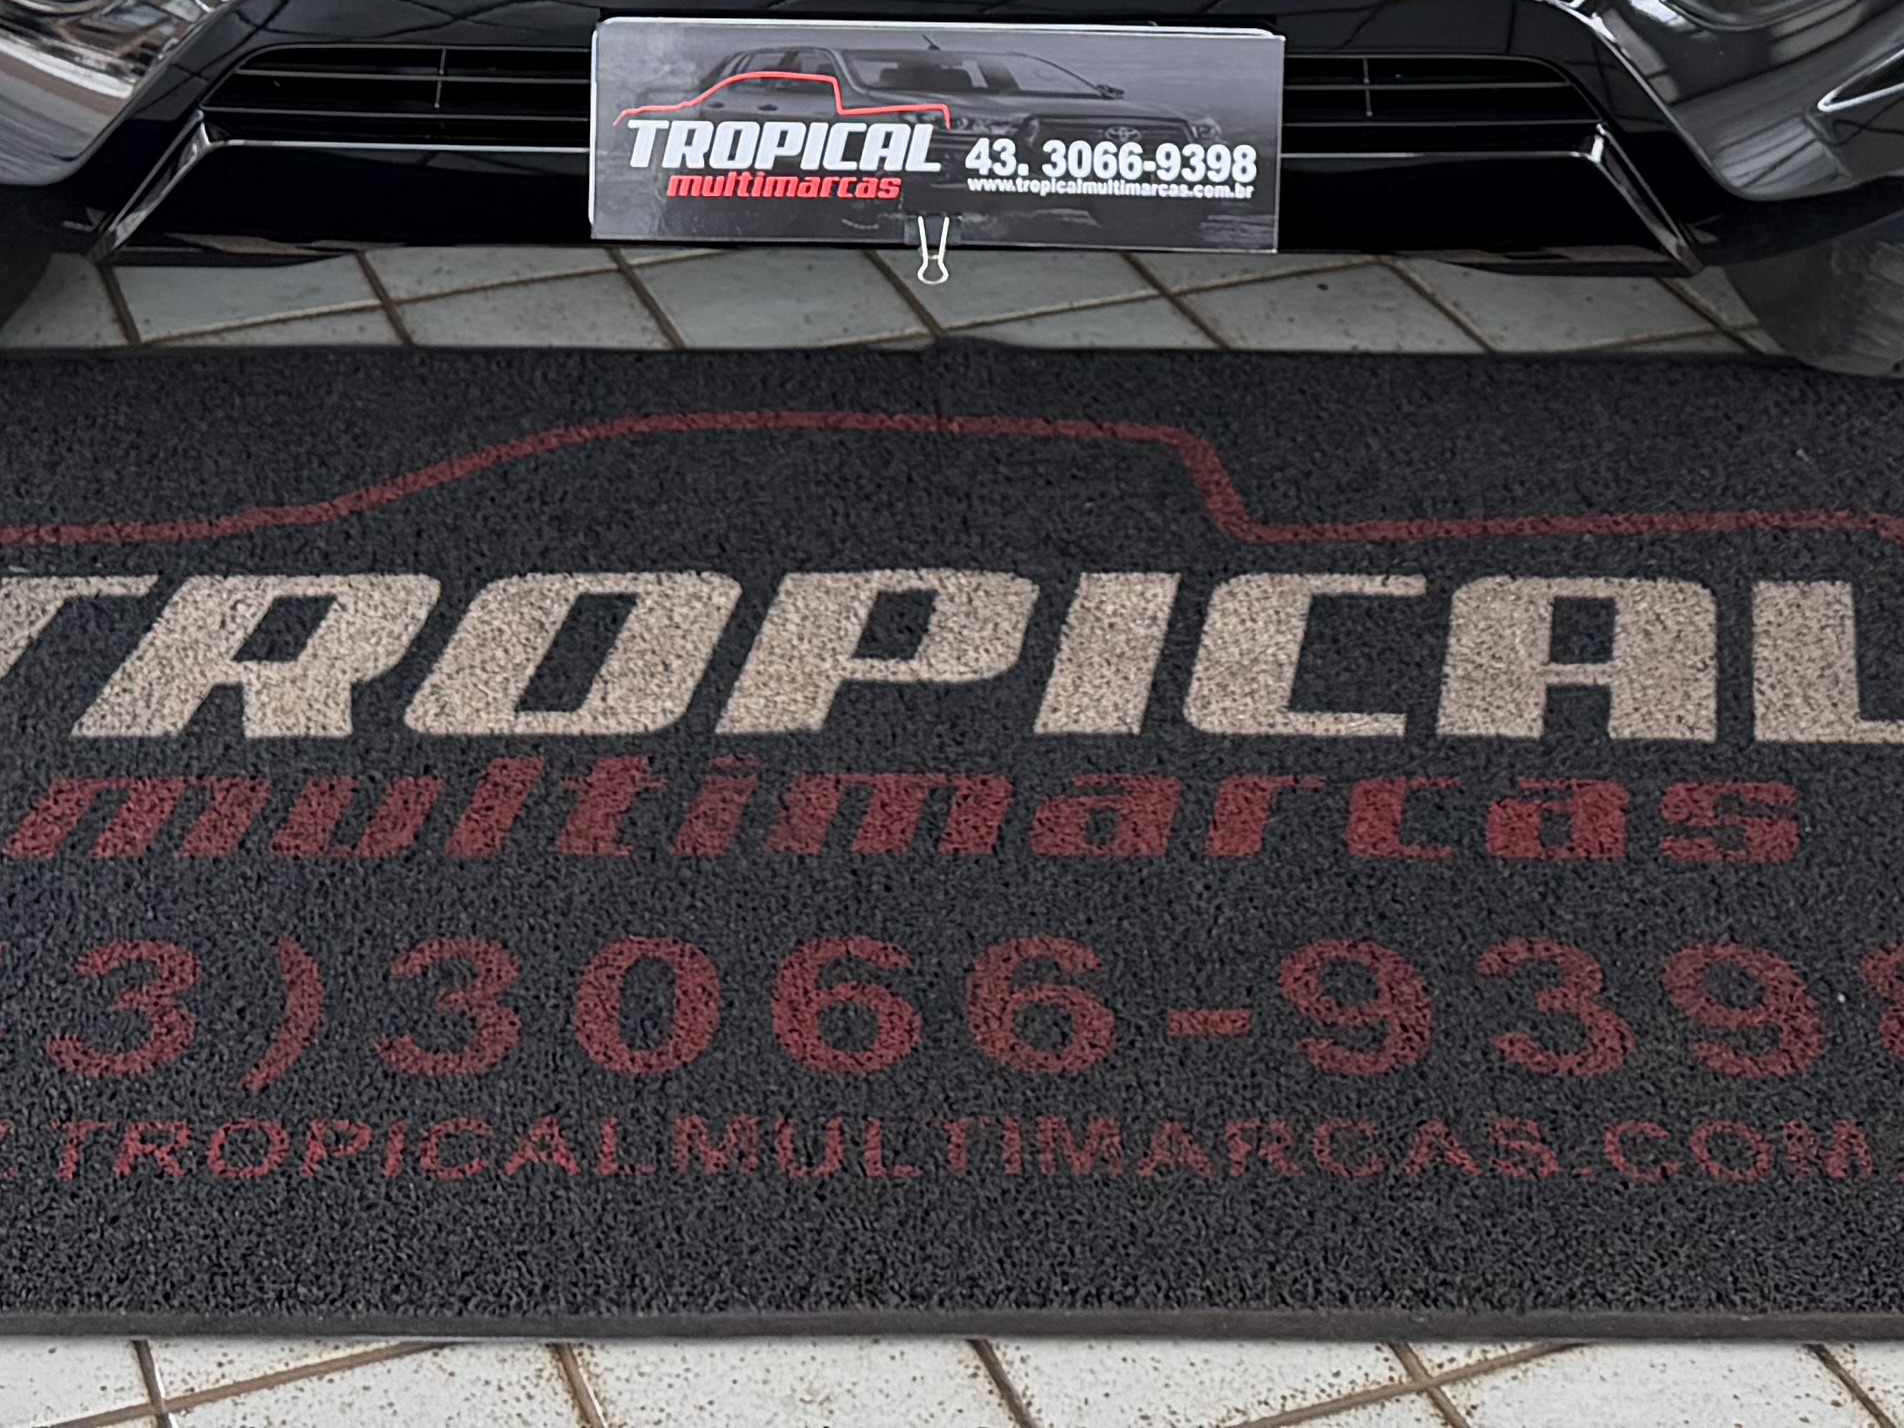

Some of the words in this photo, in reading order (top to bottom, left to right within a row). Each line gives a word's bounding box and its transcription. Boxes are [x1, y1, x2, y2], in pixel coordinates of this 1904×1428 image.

[627, 119, 942, 172] TROPICAL
[965, 137, 1029, 176] 43.
[1042, 139, 1257, 183] 3066-9398
[666, 171, 902, 199] multimarcas
[967, 177, 1254, 199] www.tropicalmultimarcas.com.br
[2, 756, 1799, 861] multimarcas
